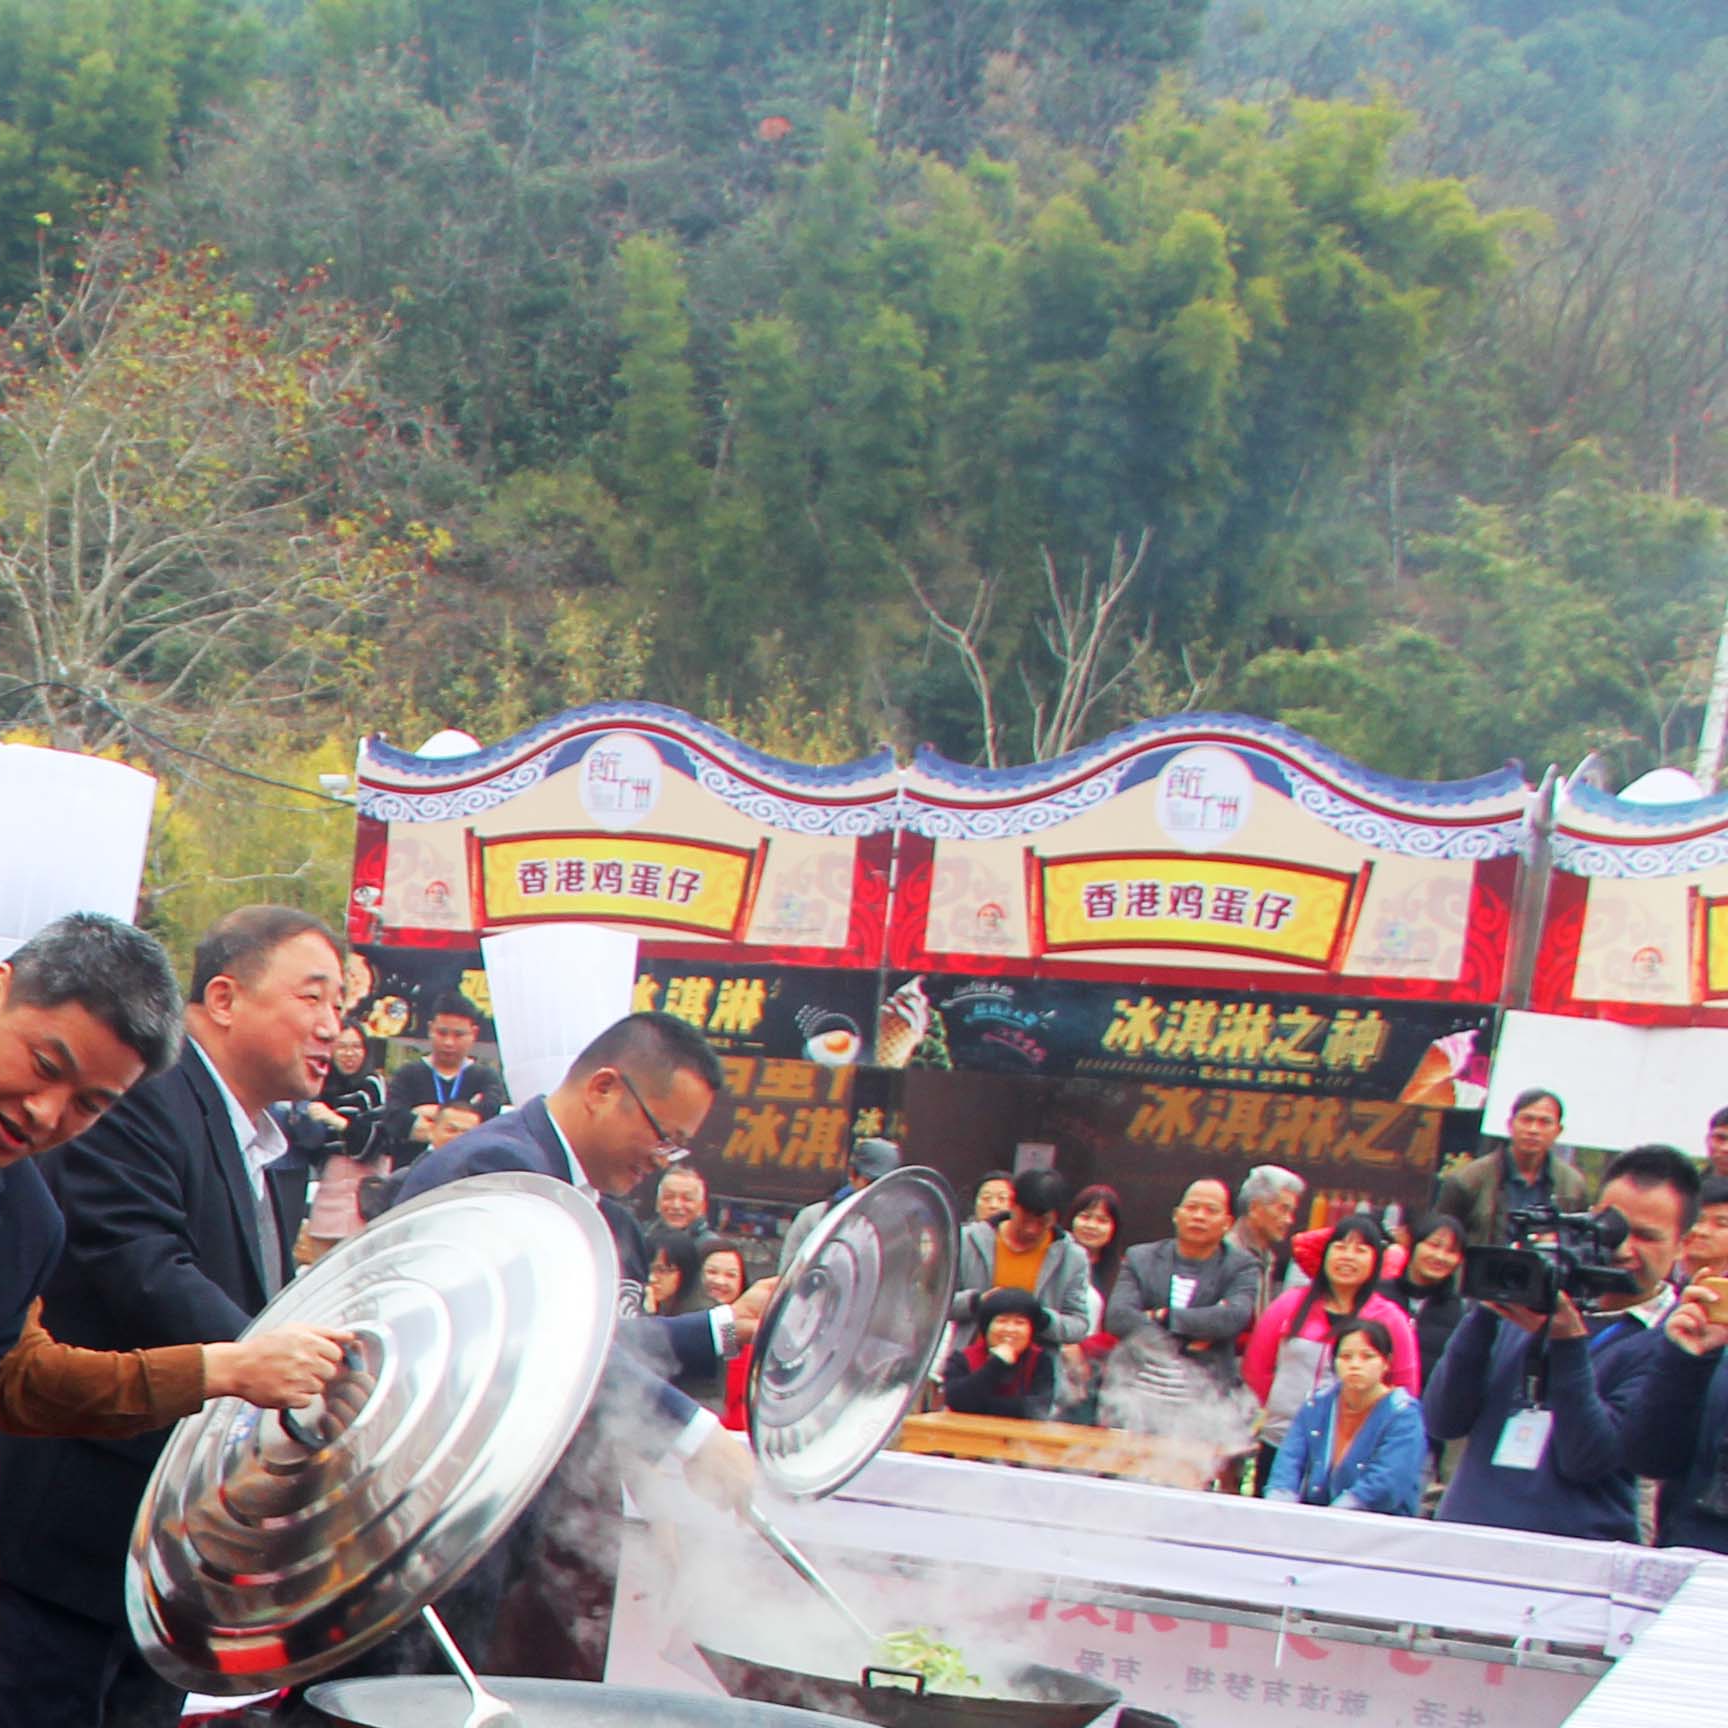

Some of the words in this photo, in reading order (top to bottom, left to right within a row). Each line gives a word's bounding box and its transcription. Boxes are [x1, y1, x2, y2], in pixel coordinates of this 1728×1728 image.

[518, 860, 701, 903] 香港鸡蛋仔
[1082, 883, 1292, 931] 香港鸡蛋仔
[1101, 997, 1390, 1073] 冰淇淋之神
